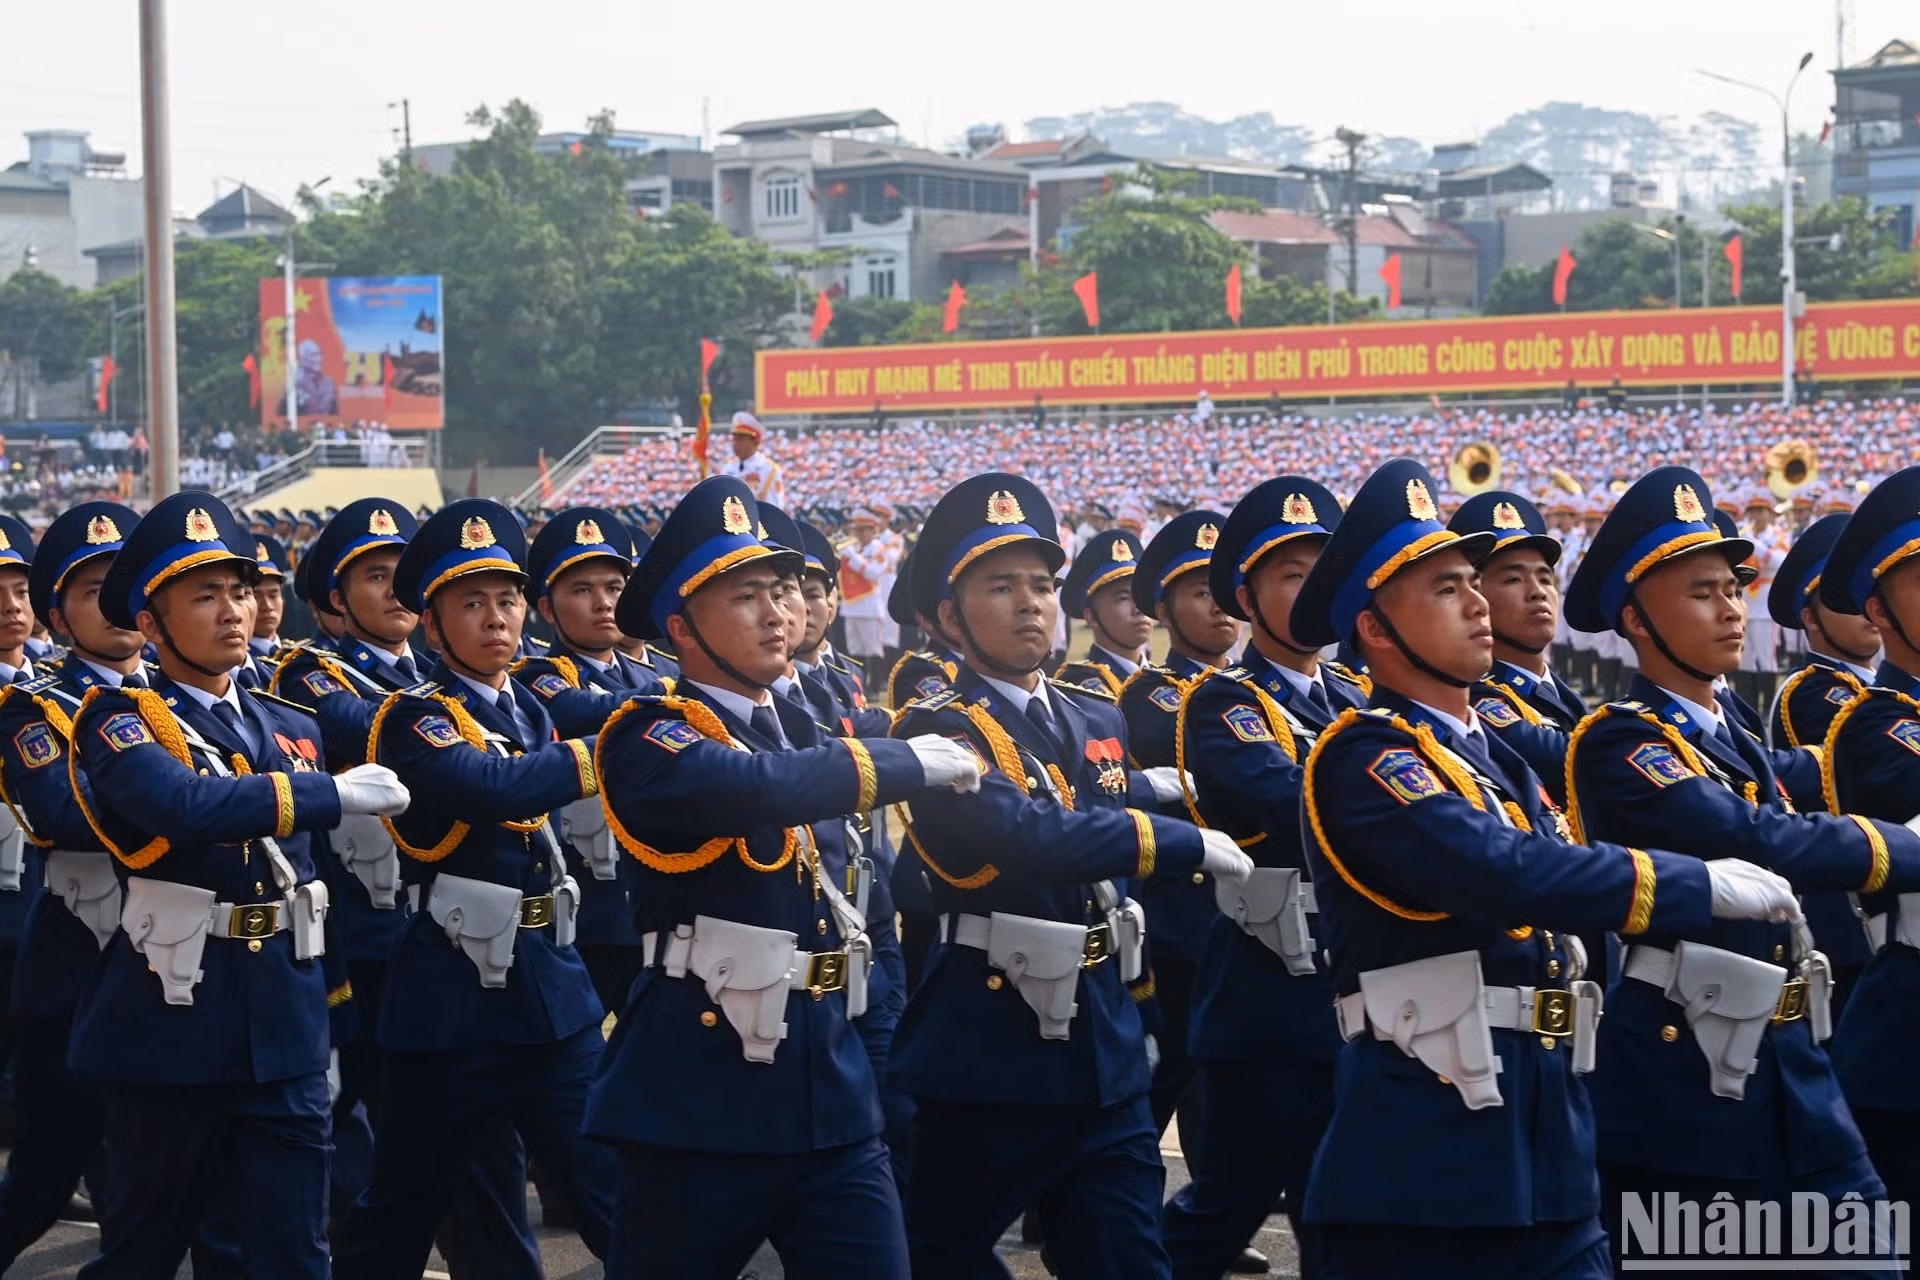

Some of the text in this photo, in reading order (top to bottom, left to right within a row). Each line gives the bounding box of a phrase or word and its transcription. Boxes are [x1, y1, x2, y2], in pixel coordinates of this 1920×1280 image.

[785, 364, 829, 397] PHÁT
[835, 367, 869, 396] HUY
[874, 365, 929, 400] MẠNH
[968, 362, 1010, 391] TINH
[1070, 349, 1127, 386] CHIẾN
[1202, 346, 1248, 389] ĐIỆN
[1254, 343, 1302, 381] BIÊN
[1308, 337, 1351, 379] PHỦ
[1357, 343, 1429, 377] TRONG
[1436, 335, 1496, 373] CÔNG
[1503, 331, 1563, 377] CUỘC
[1570, 329, 1614, 368] XÂY
[1622, 331, 1684, 374] DỰNG
[1692, 325, 1723, 365] VÀ
[1731, 319, 1779, 363] BẢO
[1826, 320, 1895, 361] VỮNG
